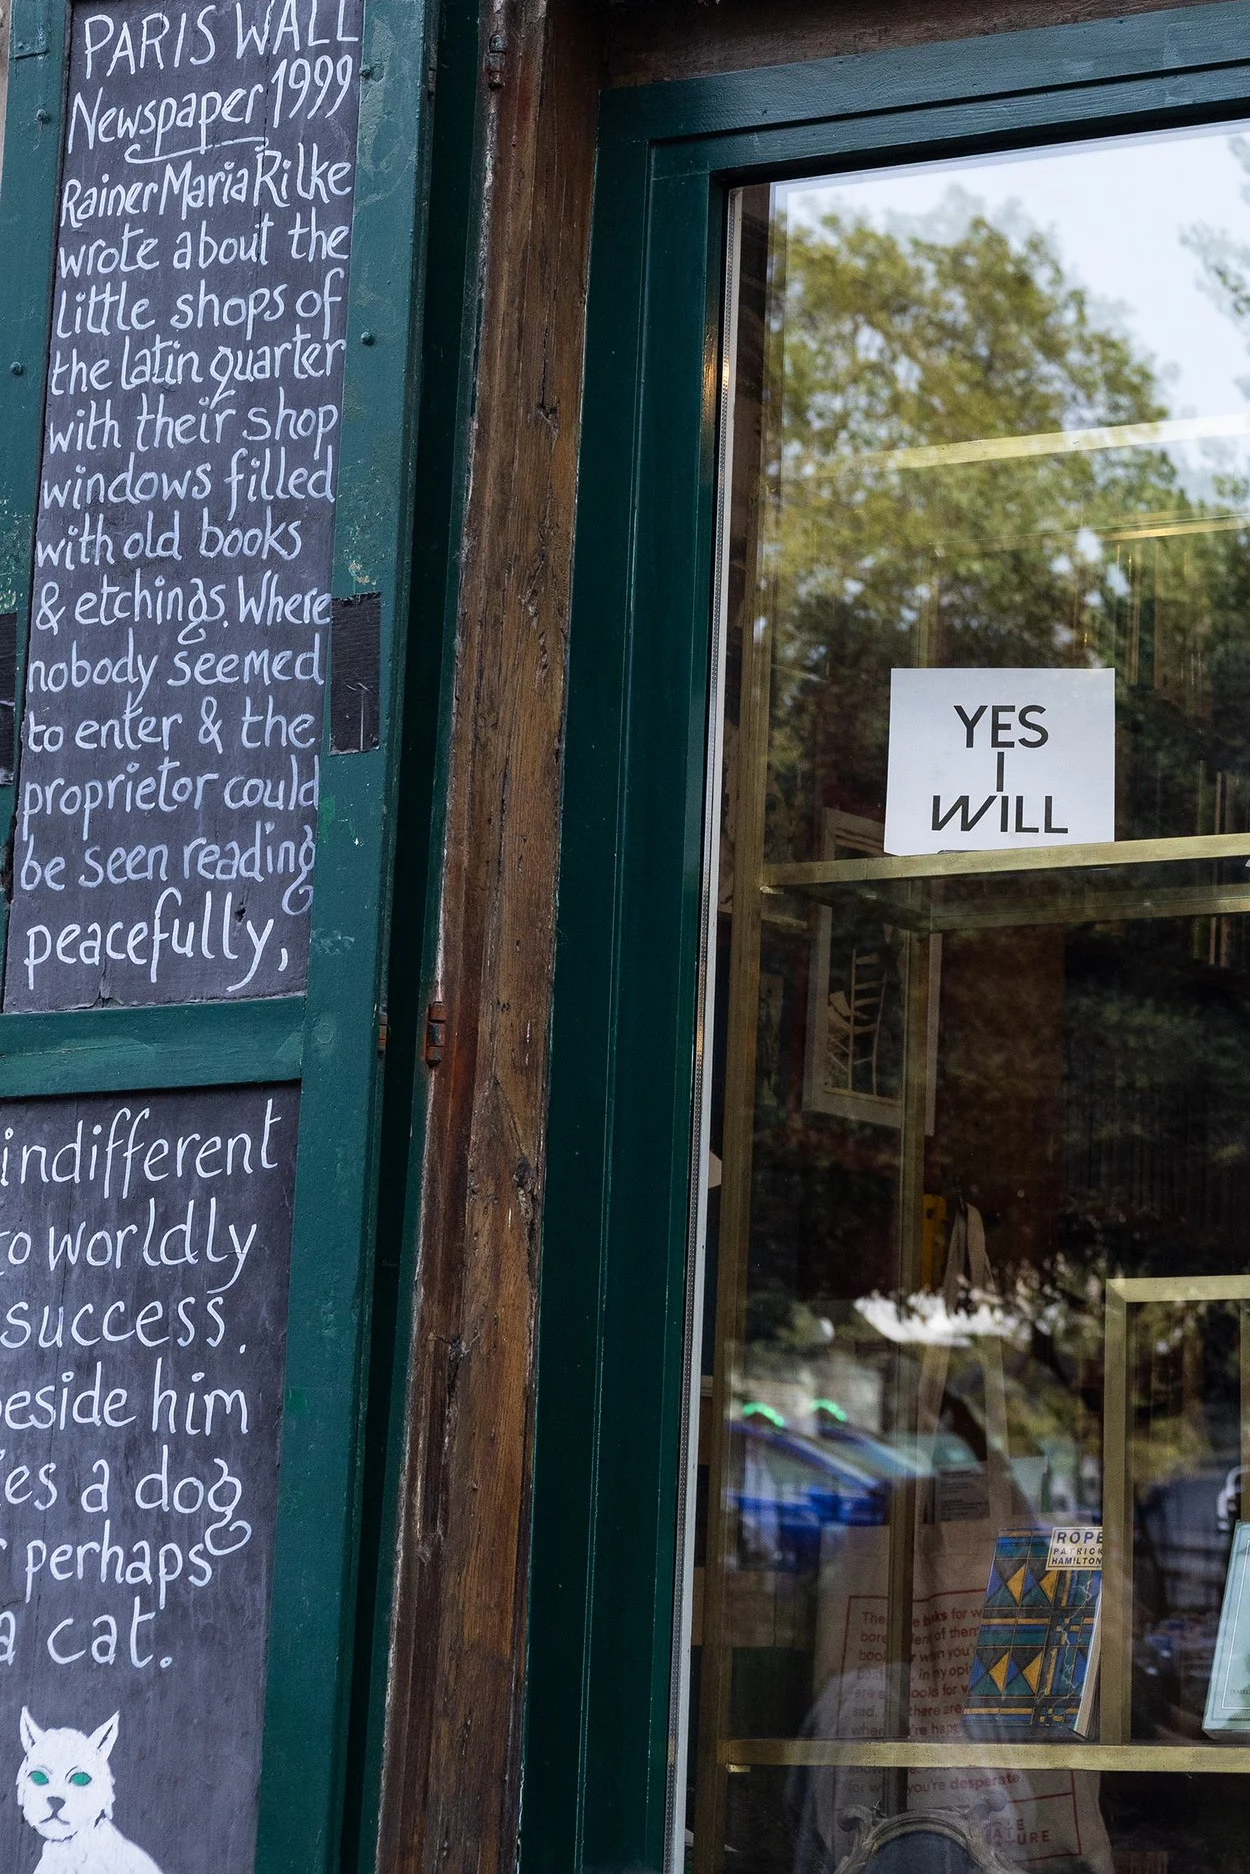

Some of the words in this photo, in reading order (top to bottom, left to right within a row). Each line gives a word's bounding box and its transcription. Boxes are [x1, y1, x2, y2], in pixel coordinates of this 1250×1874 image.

[84, 4, 219, 80] PARIS
[67, 83, 265, 163] Newspaper
[271, 53, 353, 129] 1999
[61, 169, 159, 228] Rainer
[159, 160, 248, 223] Maria
[255, 141, 351, 209] Rilke
[58, 224, 159, 278] wrote
[173, 222, 273, 270] about
[288, 206, 348, 260] the
[57, 287, 155, 339] little
[170, 275, 287, 340] shops
[296, 267, 344, 339] of
[51, 348, 116, 396] the
[121, 335, 200, 391] latin
[208, 333, 346, 408] quarter
[49, 397, 121, 455] with
[135, 393, 228, 451] their
[241, 386, 338, 460] shop
[42, 452, 212, 511] windows
[225, 445, 335, 521] filled
[35, 519, 114, 570] with
[123, 510, 181, 561] old
[199, 508, 302, 561] books
[35, 580, 66, 629] &
[238, 572, 331, 626] Where
[27, 626, 162, 706] nobody
[166, 632, 324, 686] seemed
[27, 709, 64, 752] to
[74, 698, 183, 752] enter
[197, 695, 226, 754] &
[241, 695, 316, 751] the
[953, 704, 1048, 748] YES
[22, 755, 217, 841] proprietor
[223, 752, 319, 812] could
[995, 751, 1005, 793] I
[931, 794, 1069, 834] WILL
[20, 838, 66, 892] be
[79, 836, 169, 888] seen
[182, 823, 317, 916] reading
[24, 886, 289, 992] peacefully,
[0, 1098, 282, 1199] indifferent
[48, 1195, 258, 1296] worldly
[0, 1290, 247, 1356] success.
[0, 1360, 138, 1431] eside
[151, 1357, 251, 1437] him
[80, 1458, 110, 1514] a
[134, 1444, 253, 1556] dog
[1057, 1531, 1103, 1544] ROPE
[25, 1519, 214, 1610] perhaps
[1052, 1557, 1103, 1565] HAMILTON
[1053, 1547, 1103, 1555] PATRICK
[47, 1595, 175, 1671] cat.
